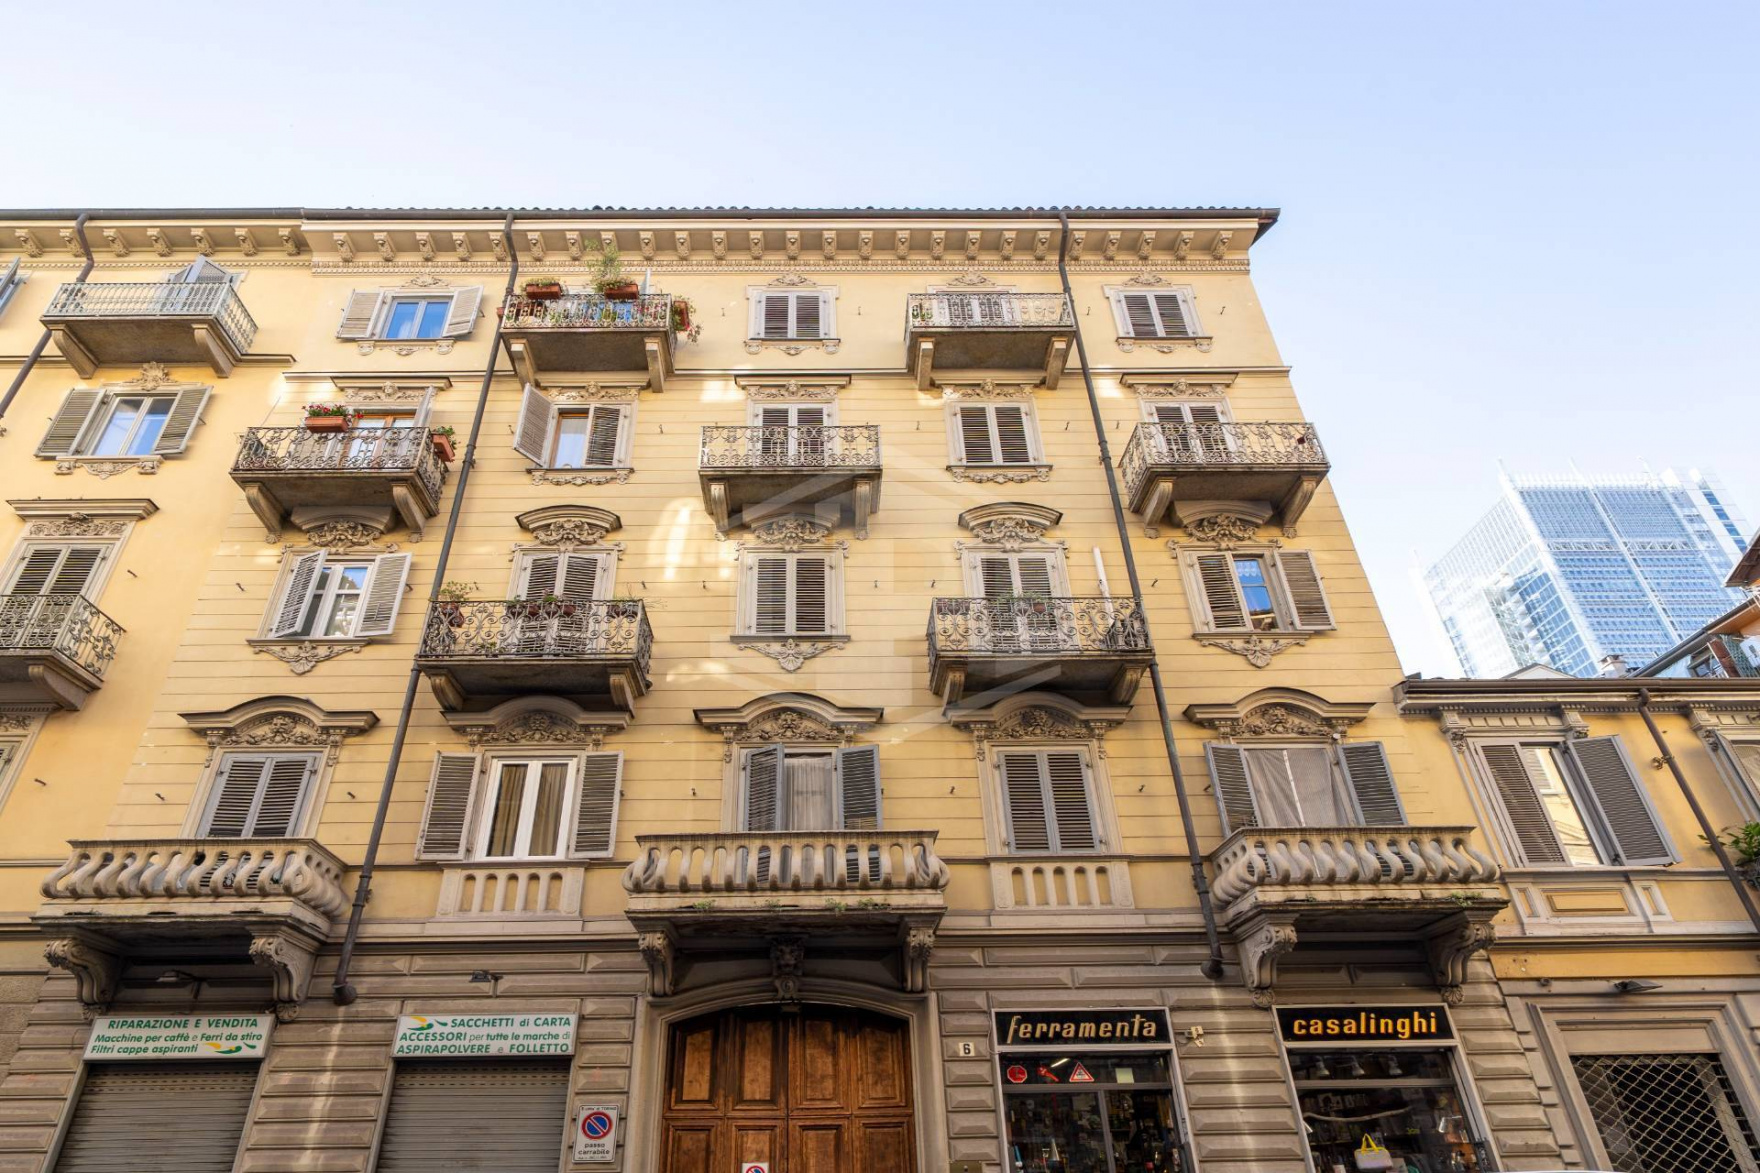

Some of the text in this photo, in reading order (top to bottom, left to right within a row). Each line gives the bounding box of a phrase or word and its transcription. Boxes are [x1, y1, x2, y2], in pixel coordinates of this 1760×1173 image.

[107, 1018, 258, 1029] RIPARAZIONE E VENDITA
[451, 1017, 571, 1028] SACCHETTI di CARTA
[1293, 1011, 1437, 1039] casalinghi
[1006, 1014, 1157, 1044] ferramenta
[94, 1033, 143, 1043] Macchine
[144, 1035, 162, 1046] per
[164, 1032, 189, 1042] caffè
[200, 1032, 223, 1042] Ferri
[225, 1031, 238, 1041] da
[240, 1031, 262, 1041] stiro
[399, 1031, 571, 1043] ACCESSORI per tutte le marche di
[90, 1044, 198, 1055] Filtri cappe aspiranti
[396, 1044, 490, 1054] ASPIRAPOLVERE
[509, 1043, 569, 1053] FOLLETTO
[963, 1043, 971, 1055] 6
